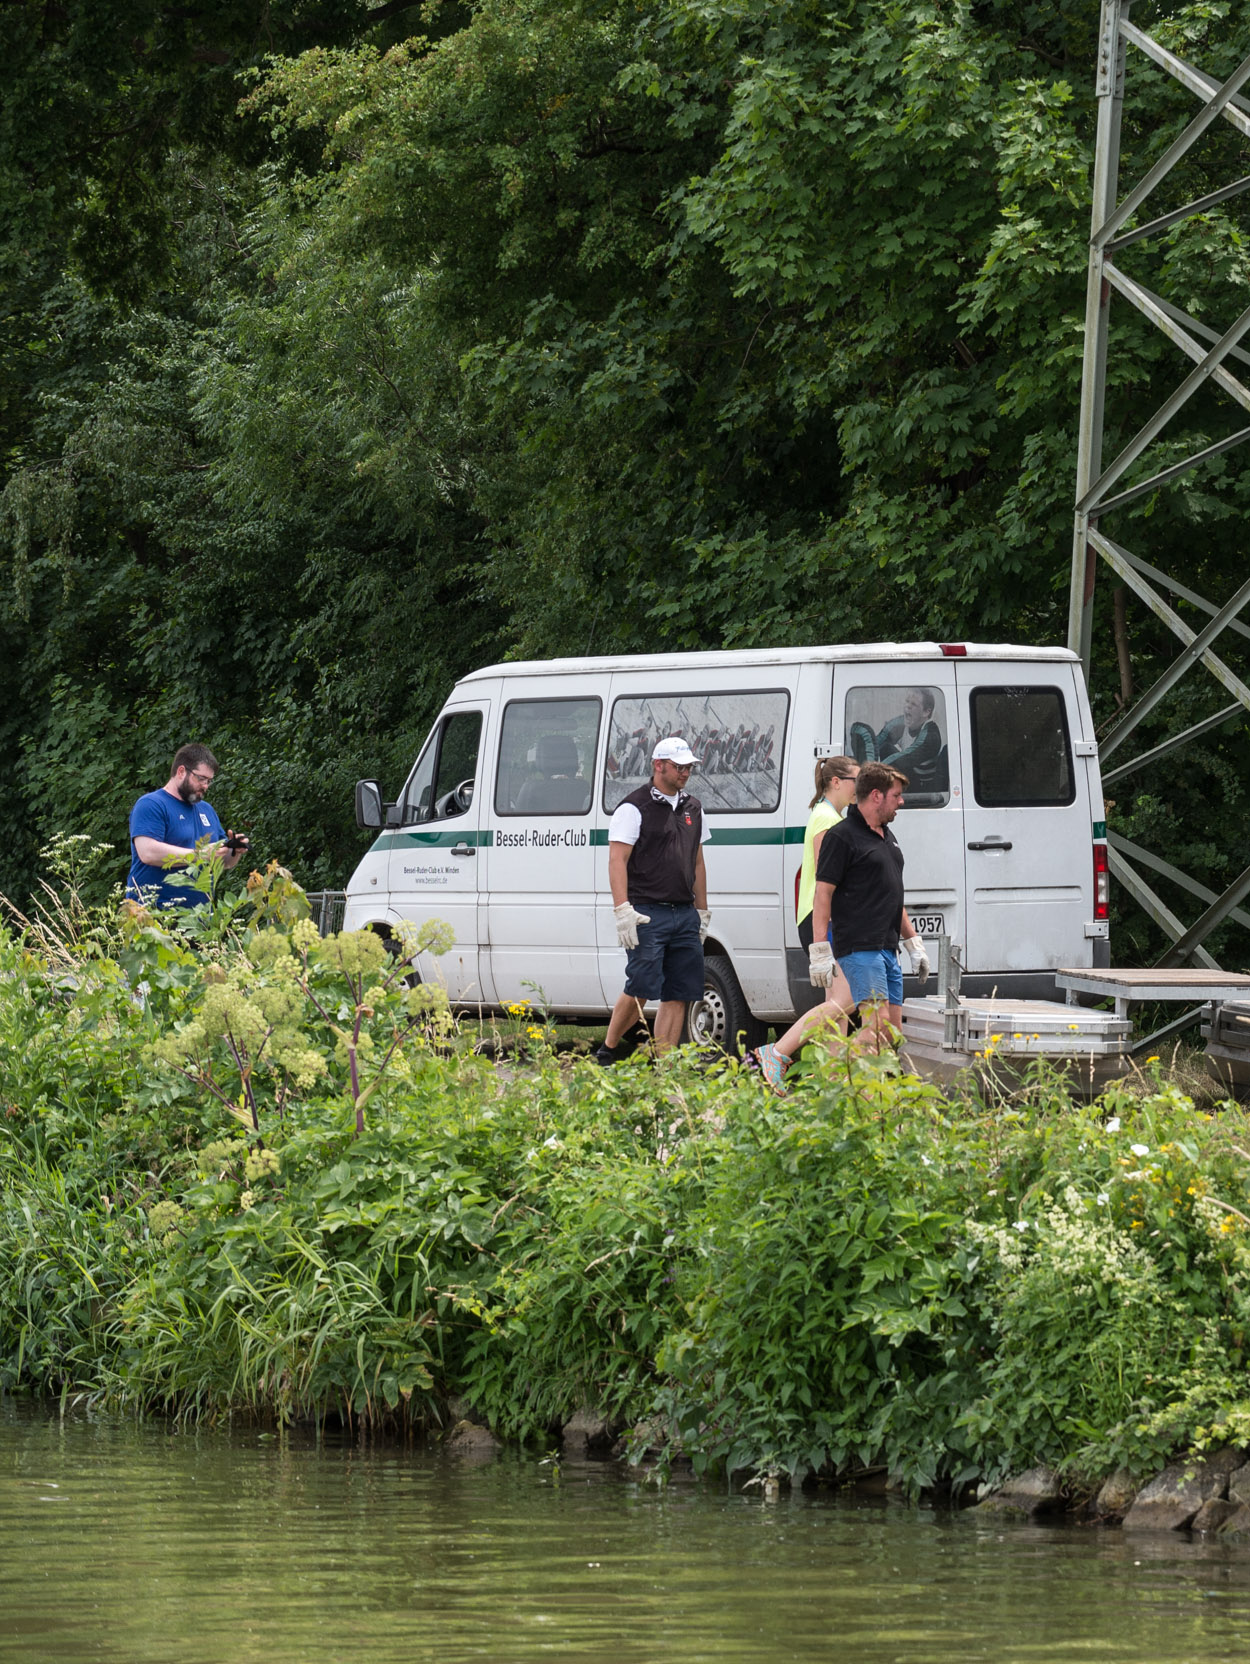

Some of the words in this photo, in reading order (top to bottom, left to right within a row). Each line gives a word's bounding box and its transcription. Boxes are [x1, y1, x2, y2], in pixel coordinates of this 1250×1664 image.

[496, 829, 587, 847] Bessel-Ruder-Club
[403, 866, 437, 874] Bessel-Ruder-Club
[911, 917, 942, 933] 1957
